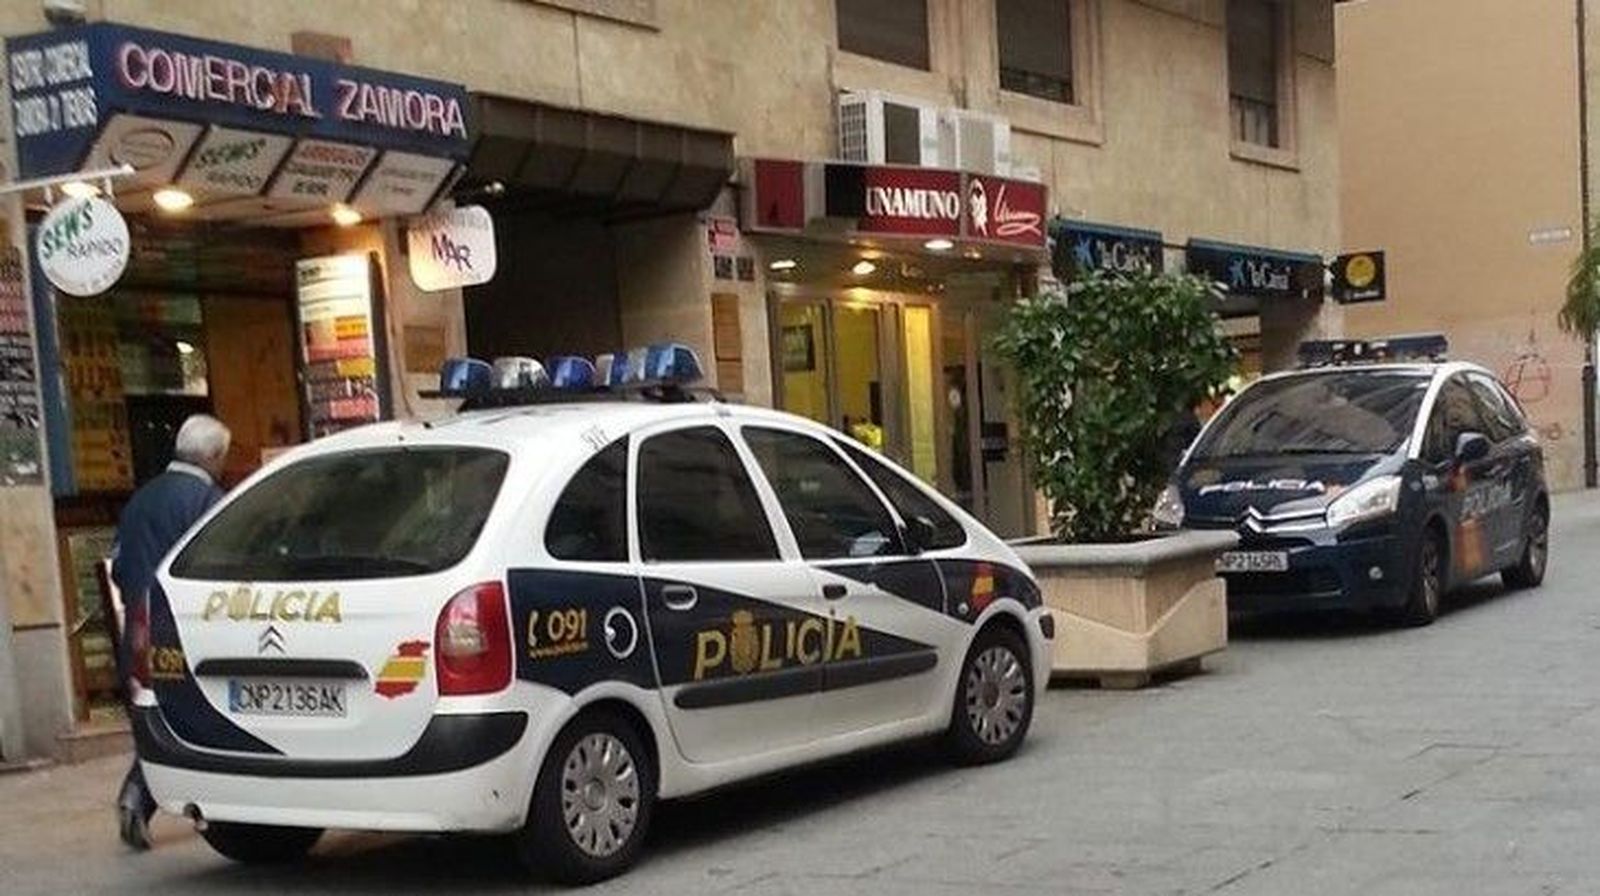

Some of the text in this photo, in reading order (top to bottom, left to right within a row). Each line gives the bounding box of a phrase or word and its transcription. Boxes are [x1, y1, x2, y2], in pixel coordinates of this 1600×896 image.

[119, 43, 322, 118] COMERCIAL
[338, 79, 467, 139] ZAMORA
[865, 187, 960, 219] UNAMUNO
[431, 233, 473, 273] MAR
[202, 586, 342, 622] POLICIA
[547, 608, 587, 641] 091
[694, 609, 862, 680] POLICIA
